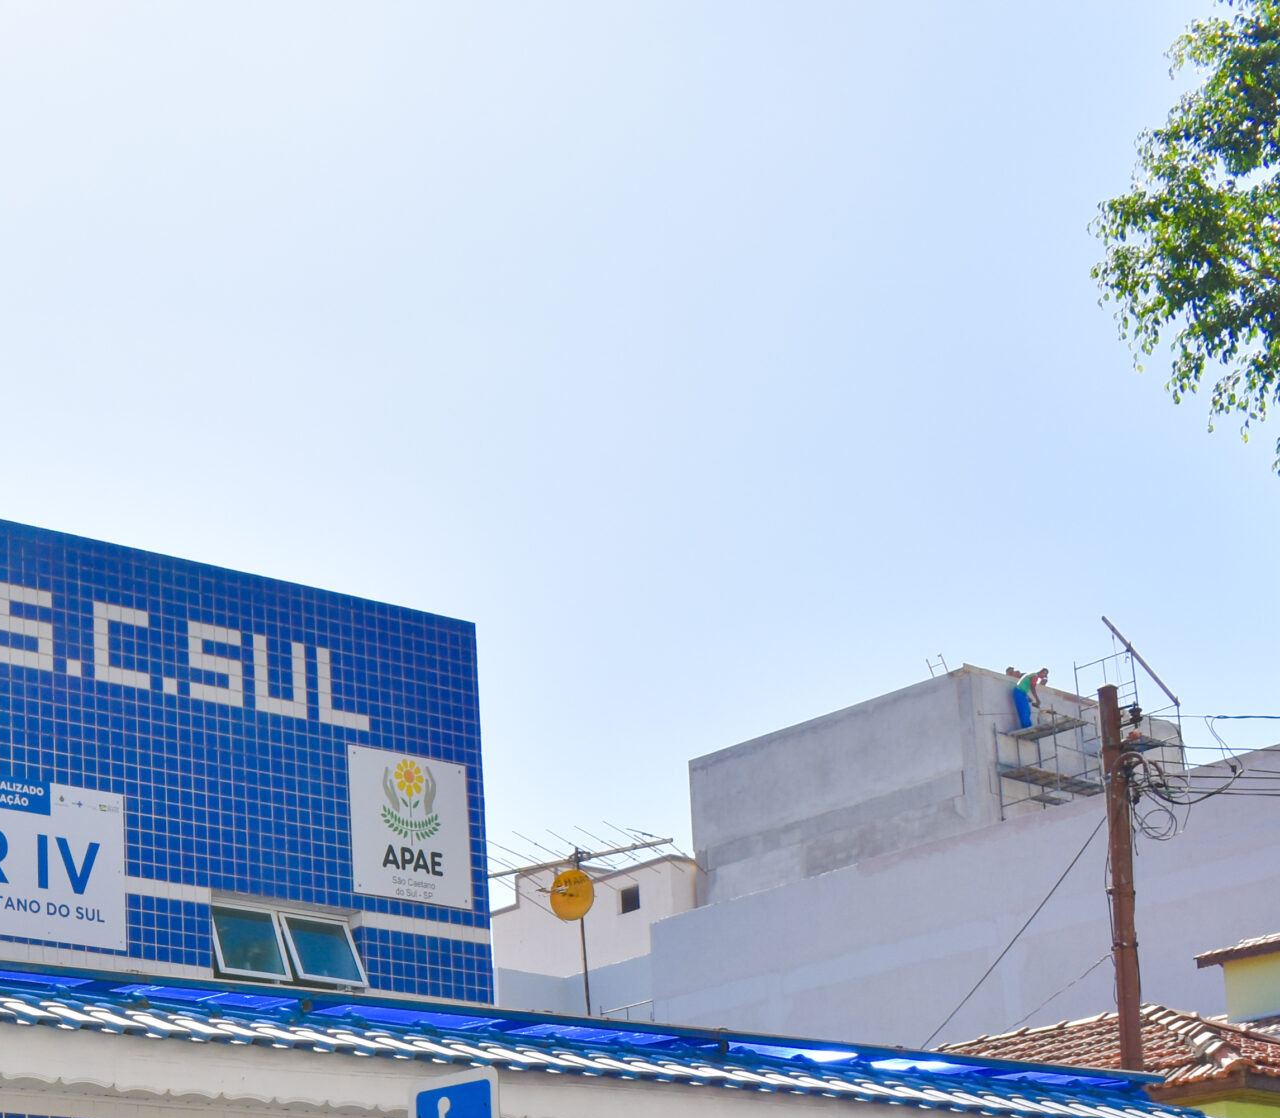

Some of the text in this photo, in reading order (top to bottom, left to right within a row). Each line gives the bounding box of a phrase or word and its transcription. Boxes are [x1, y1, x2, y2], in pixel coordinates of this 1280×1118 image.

[37, 833, 100, 895] IV
[382, 844, 444, 877] APAE
[392, 875, 436, 890] São Caetano
[395, 888, 405, 896] do
[406, 889, 418, 898] Sul
[423, 891, 434, 900] SP
[46, 903, 71, 918] DO
[75, 906, 105, 923] SUL
